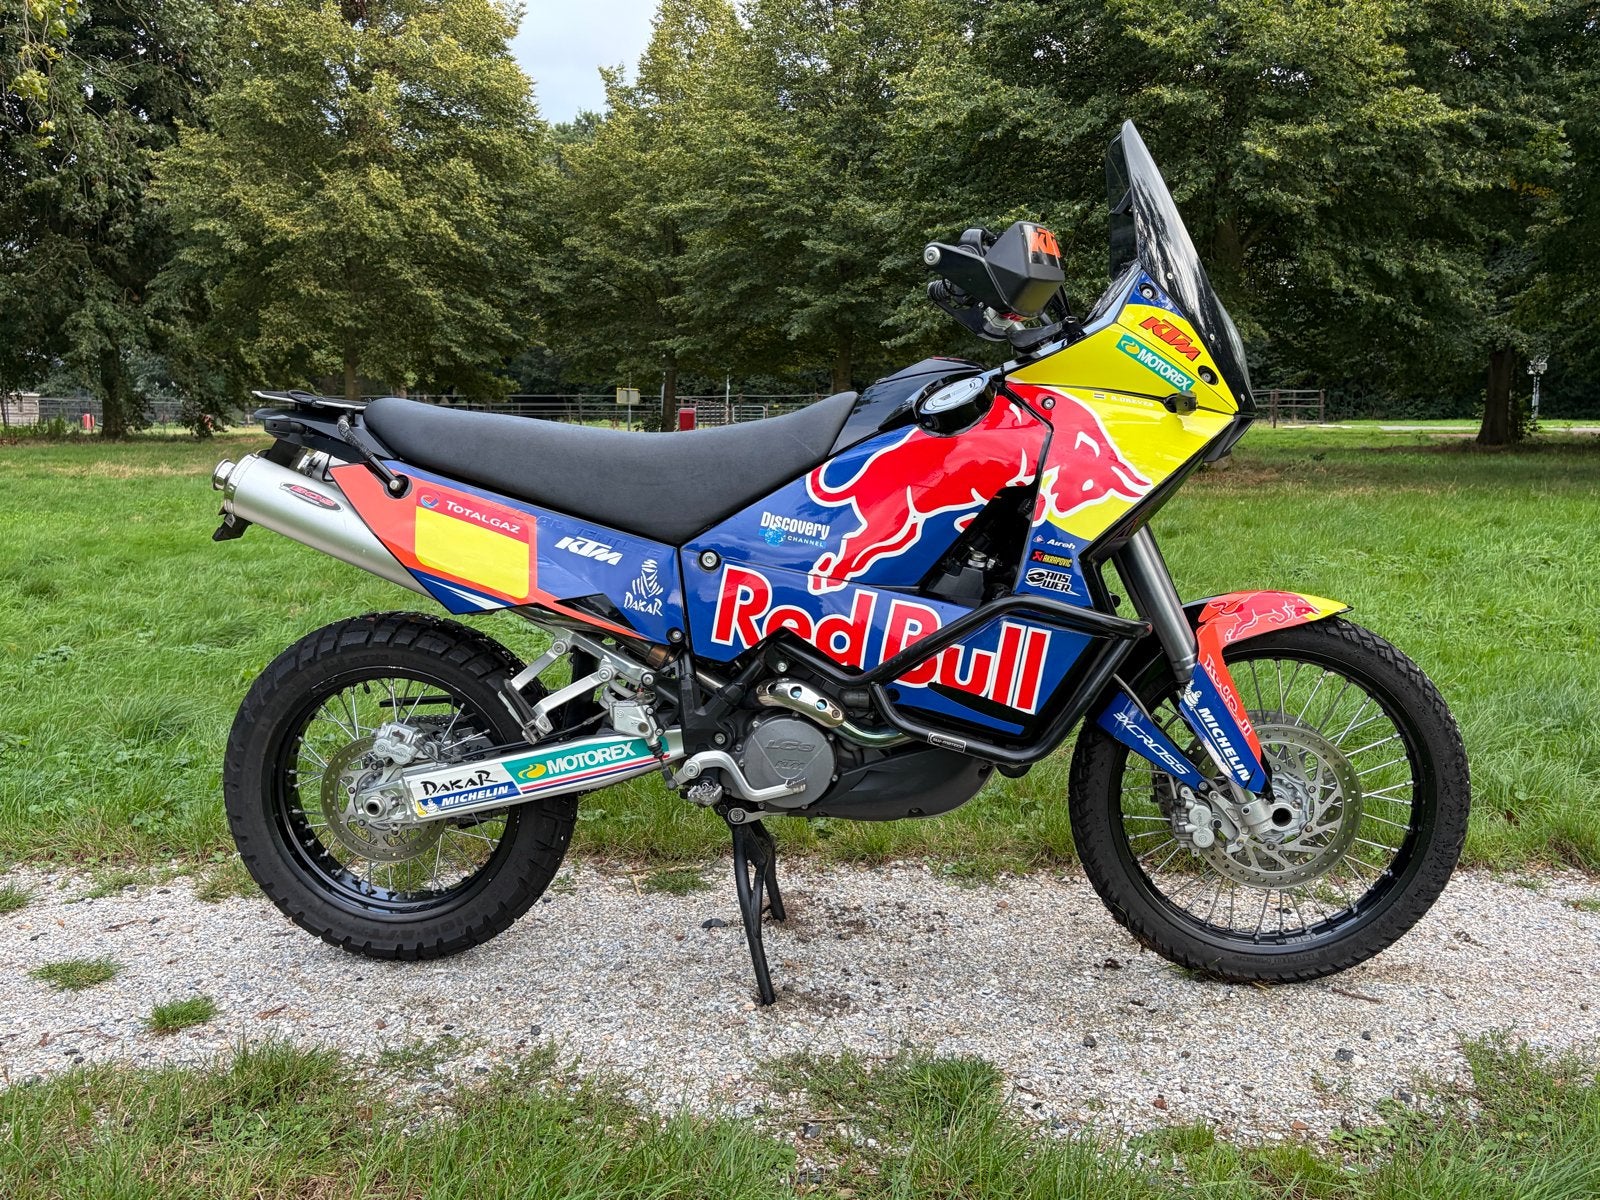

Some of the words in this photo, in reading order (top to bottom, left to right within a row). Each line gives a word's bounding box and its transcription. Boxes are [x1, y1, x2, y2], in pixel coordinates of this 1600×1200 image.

[1139, 316, 1201, 362] KTM
[1137, 348, 1191, 391] MOTOREX
[760, 511, 830, 541] Discovery
[554, 536, 623, 566] KTM
[787, 535, 824, 548] CHANNEL
[624, 591, 663, 617] DAKAR
[711, 563, 878, 670] Red
[880, 597, 1052, 715] Bull
[545, 741, 636, 775] MOTOREX
[1198, 707, 1250, 782] MICHELIN
[421, 770, 498, 796] DAKAR
[441, 785, 509, 807] MICHELIN
